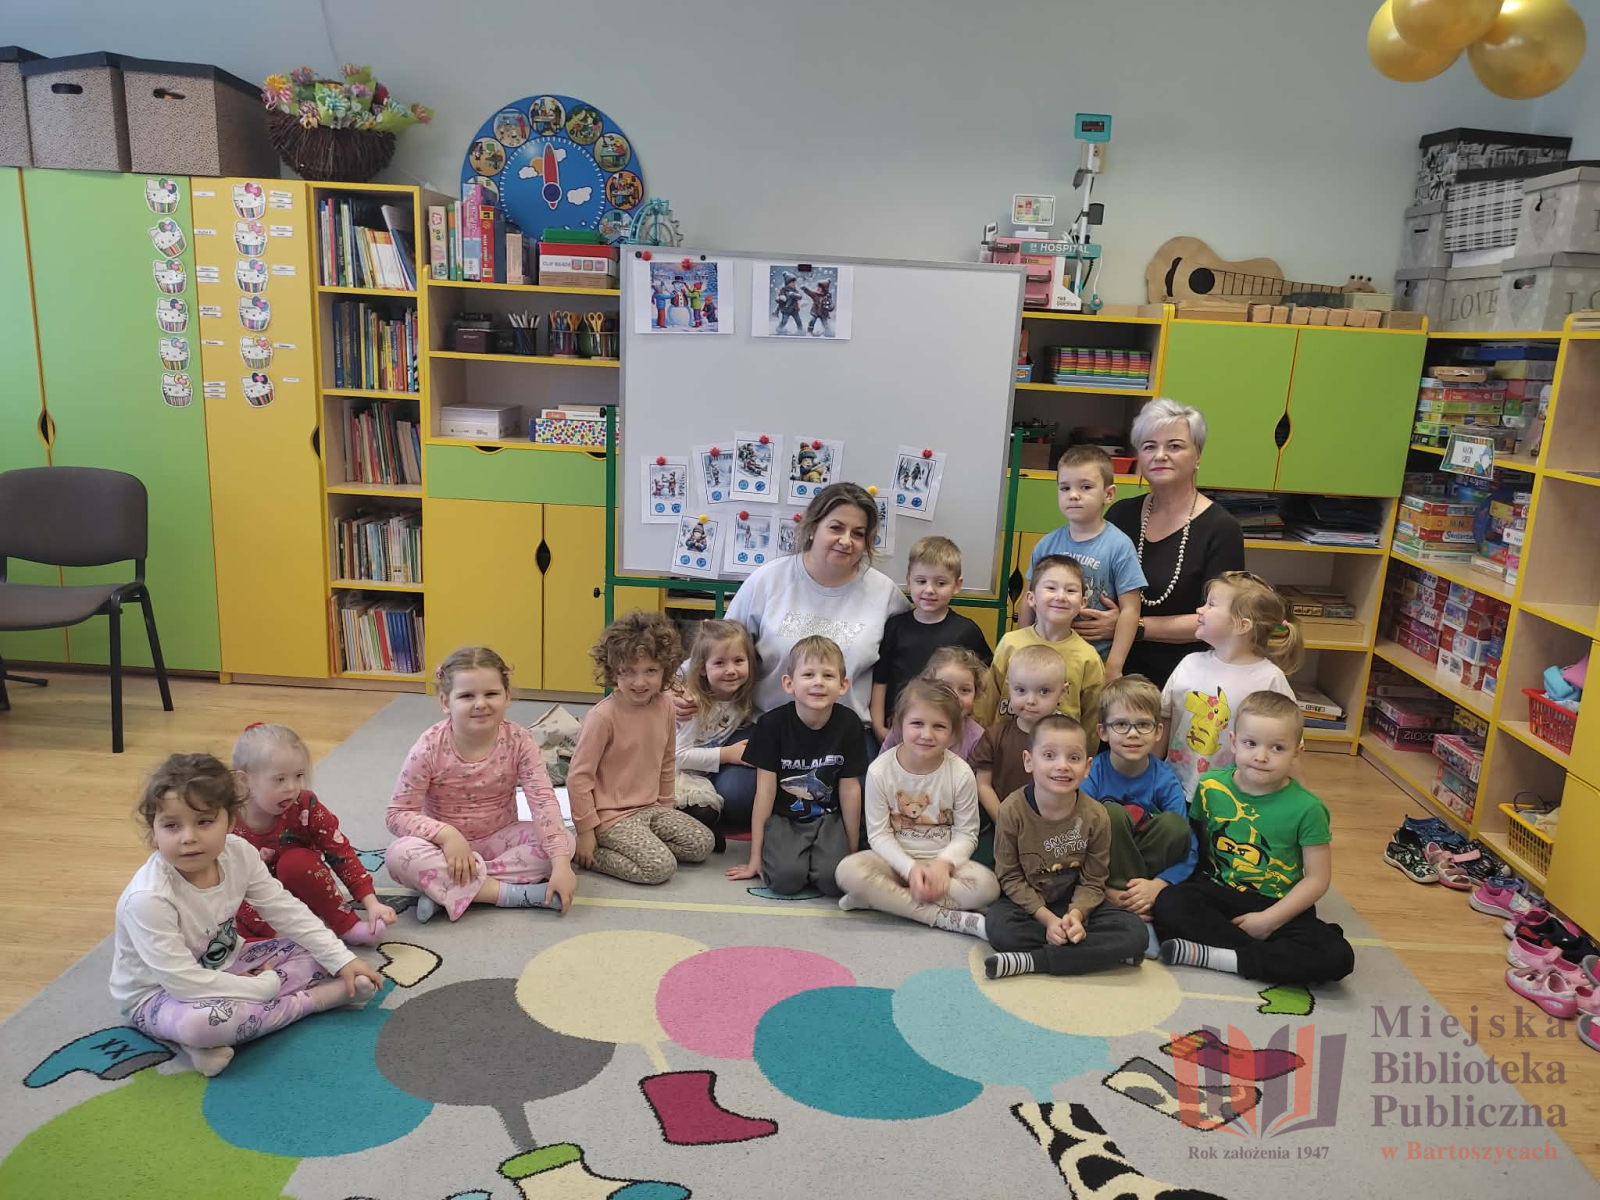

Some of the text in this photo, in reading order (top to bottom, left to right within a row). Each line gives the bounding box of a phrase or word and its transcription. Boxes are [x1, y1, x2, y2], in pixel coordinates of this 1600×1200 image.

[1040, 243, 1089, 254] HOSPITAL
[1449, 287, 1498, 320] LOVE
[1043, 830, 1081, 852] SNACK
